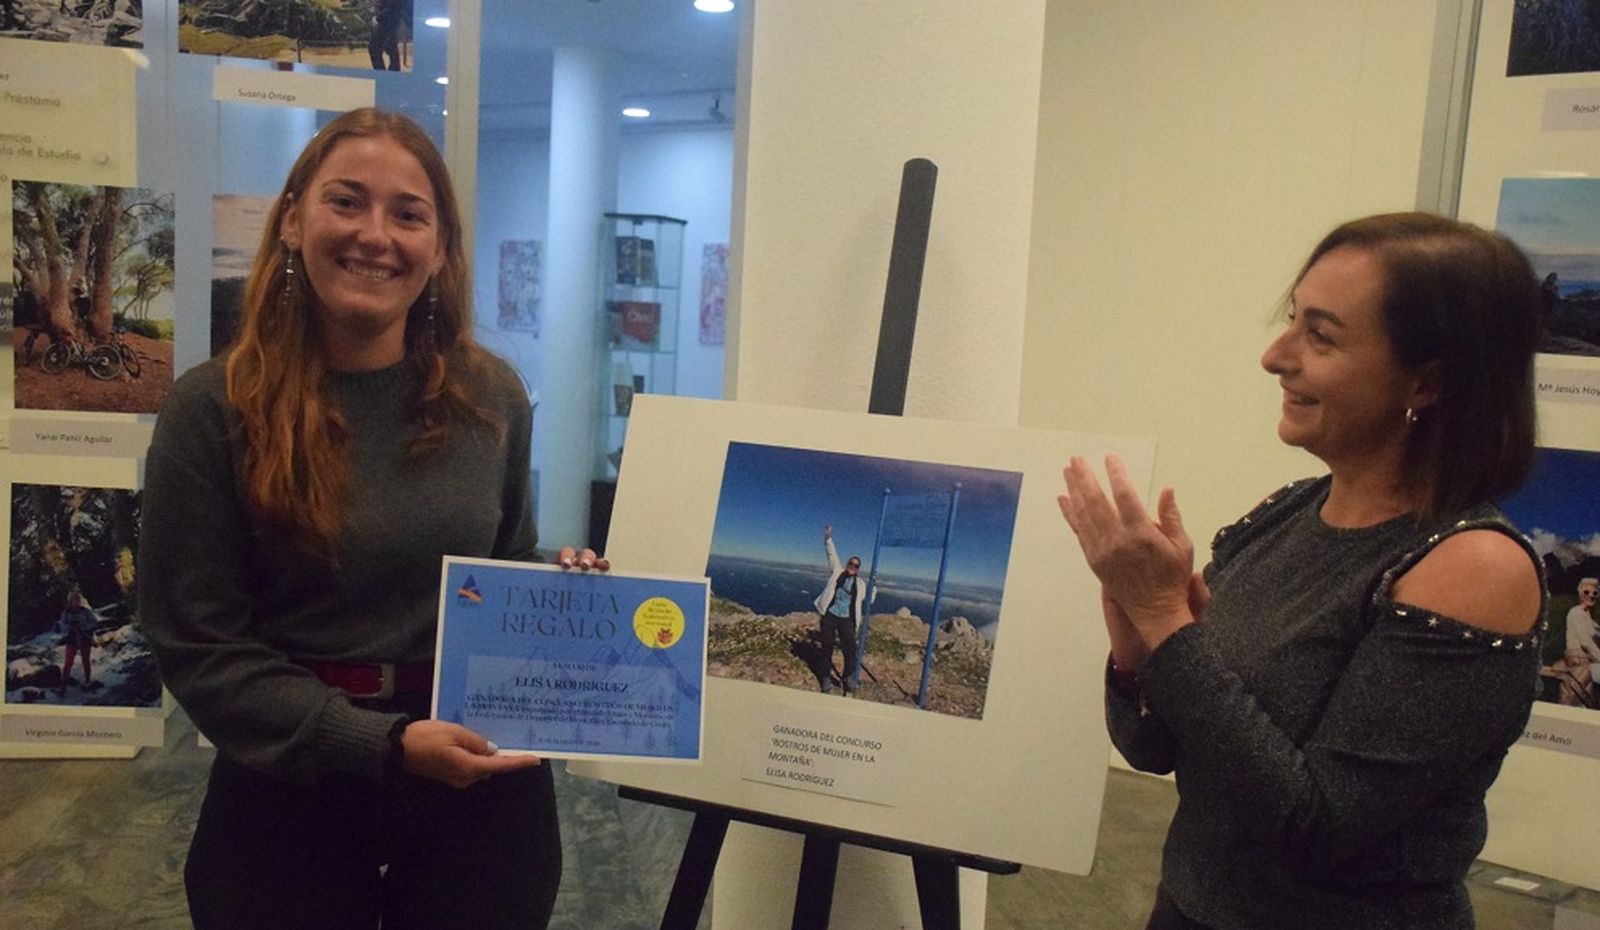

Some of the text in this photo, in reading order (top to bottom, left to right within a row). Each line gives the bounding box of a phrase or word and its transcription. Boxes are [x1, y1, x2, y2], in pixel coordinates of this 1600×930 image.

[238, 89, 296, 102] Susana Ortega
[17, 146, 33, 157] de
[37, 147, 81, 161] Estudio
[83, 435, 113, 444] Aguilar
[500, 584, 619, 615] TARJETA
[500, 612, 617, 640] REGALO
[514, 676, 551, 689] ELISA
[86, 730, 122, 739] Montero
[772, 724, 883, 751] GANADORA DEL CONCURSO
[1532, 732, 1548, 740] del
[1549, 734, 1572, 745] Amo
[810, 744, 822, 754] DE
[823, 747, 850, 759] MUJER
[851, 752, 864, 762] EN
[865, 754, 876, 763] LA
[766, 767, 787, 778] ELISA
